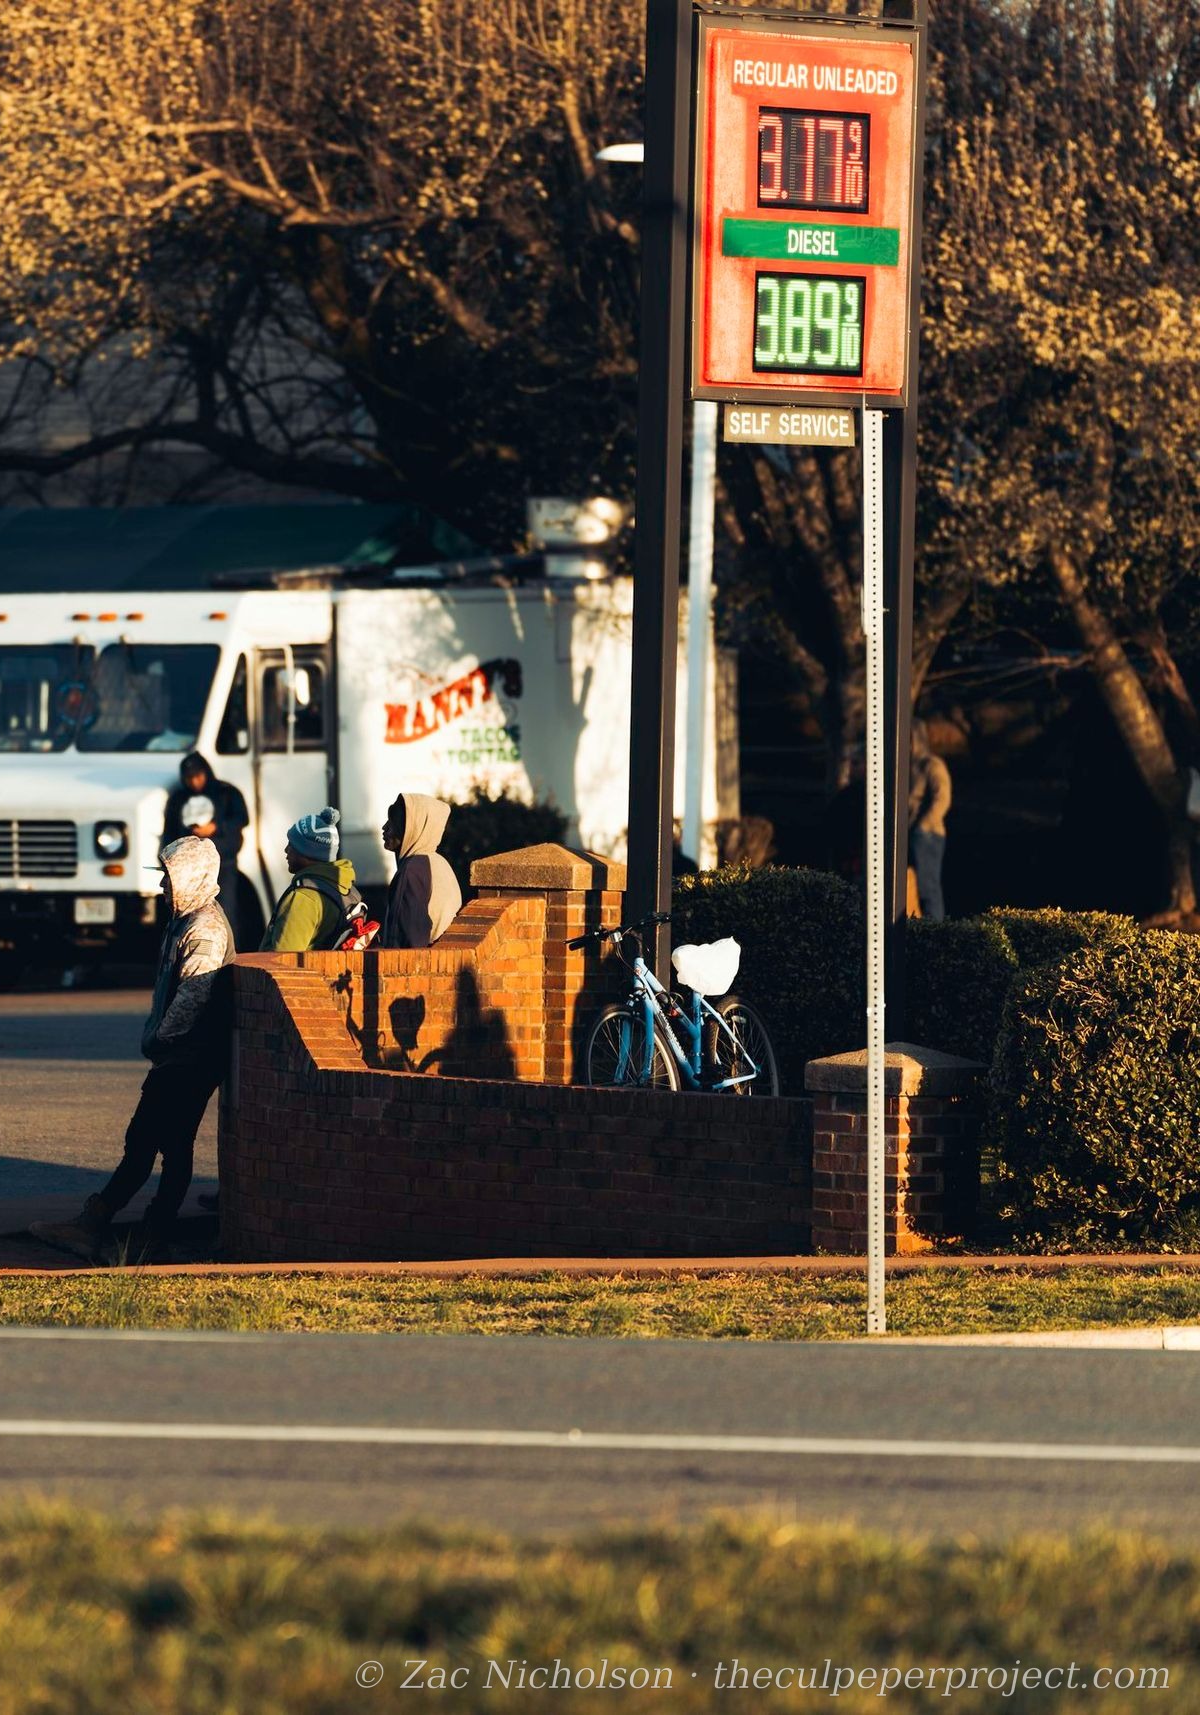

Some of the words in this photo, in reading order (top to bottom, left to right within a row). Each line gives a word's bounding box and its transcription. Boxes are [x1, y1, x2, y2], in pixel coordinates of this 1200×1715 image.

[733, 59, 809, 89] REGULAR
[813, 66, 898, 95] UNLEADED
[787, 229, 839, 256] DIESEL
[729, 411, 771, 436] SELF
[778, 413, 850, 438] SERVICE
